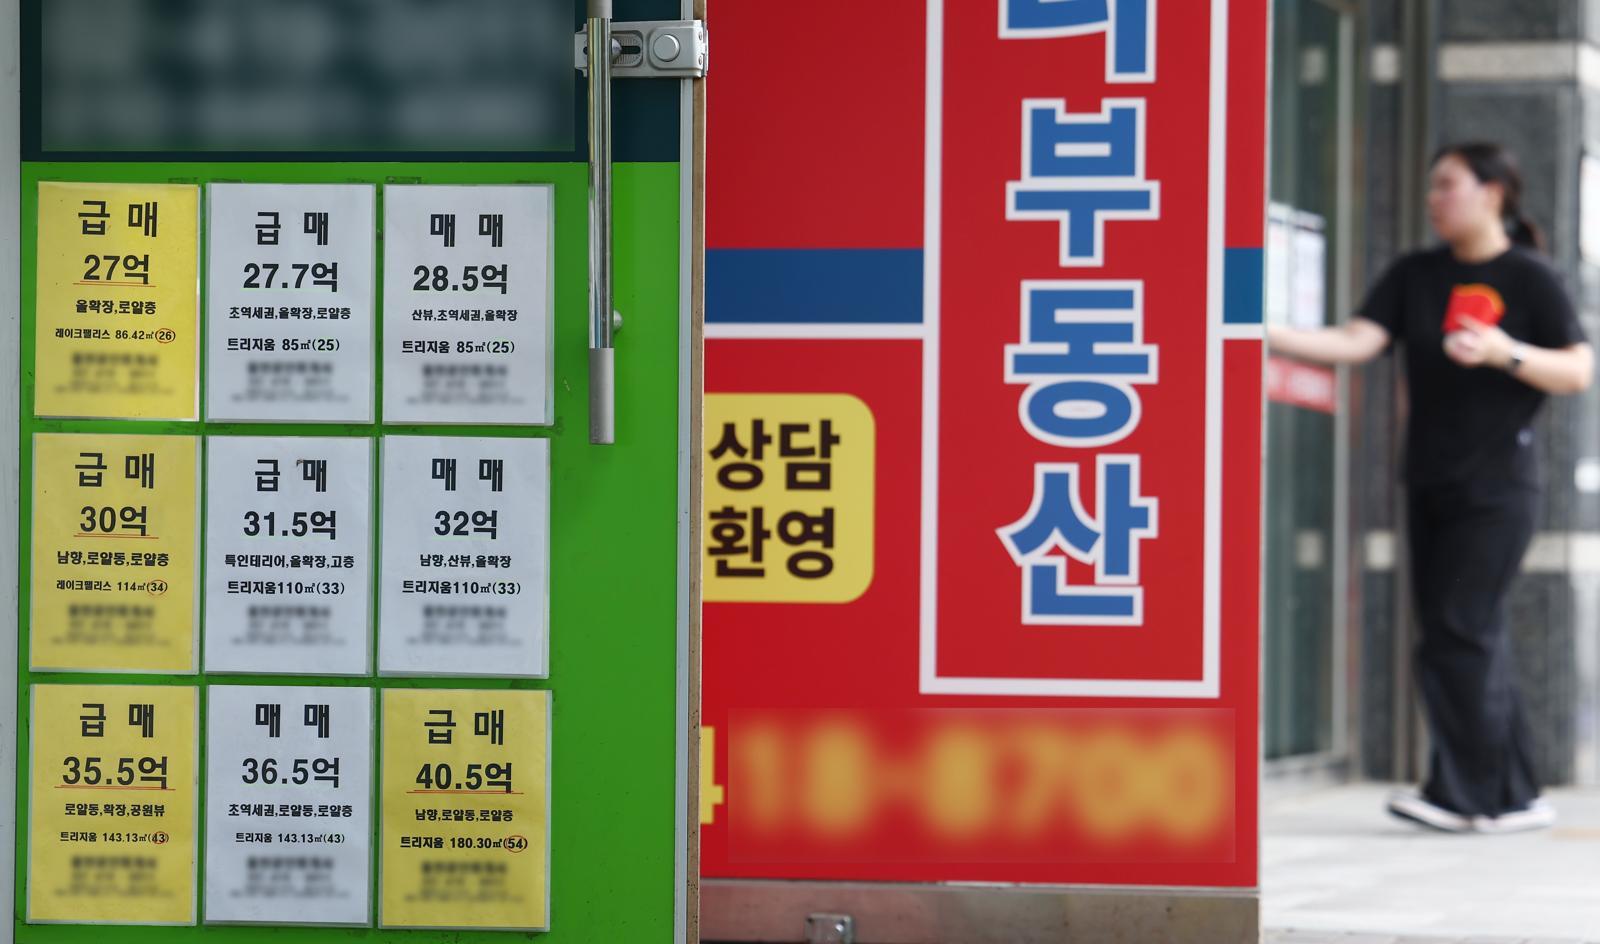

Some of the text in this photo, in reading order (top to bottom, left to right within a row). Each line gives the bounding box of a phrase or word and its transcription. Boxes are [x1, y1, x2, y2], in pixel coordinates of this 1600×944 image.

[77, 200, 158, 238] 급 매
[254, 211, 329, 246] 급 매
[429, 213, 504, 248] 매 매
[81, 254, 150, 286] 27억
[243, 261, 339, 293] 27.7억
[412, 263, 508, 295] 28.5억
[54, 327, 111, 340] 레이크팰리스
[226, 337, 276, 352] 트리지움
[401, 340, 451, 354] 트리지움
[74, 452, 155, 490] 급 매
[708, 418, 841, 492] 상담
[254, 458, 327, 493] 급 매
[431, 458, 504, 493] 매 매
[79, 505, 150, 539] 30억
[243, 510, 337, 541] 31.5억
[433, 509, 498, 540] 32억
[707, 506, 835, 580] 환영
[56, 579, 112, 592] 레이크팰리스
[79, 703, 155, 739] 급 매
[255, 703, 330, 739] 매 매
[423, 709, 505, 746] 급 매
[62, 756, 168, 790] 35.5억
[241, 757, 340, 789] 36.5억
[414, 762, 514, 793] 40.5억
[59, 831, 98, 843] 트리지움
[235, 832, 273, 844] 트리지움
[399, 836, 445, 849] 트리지움
